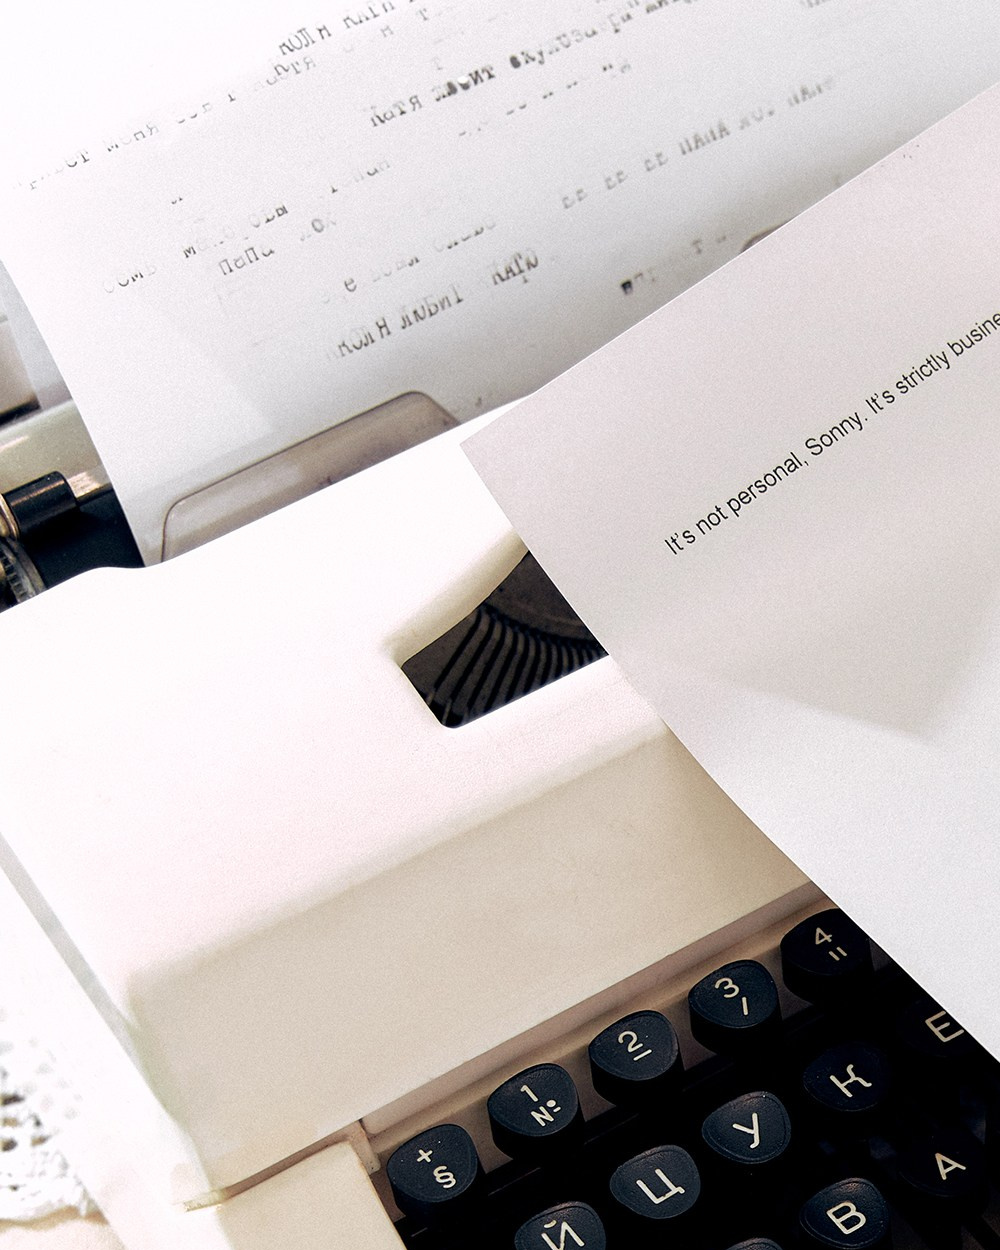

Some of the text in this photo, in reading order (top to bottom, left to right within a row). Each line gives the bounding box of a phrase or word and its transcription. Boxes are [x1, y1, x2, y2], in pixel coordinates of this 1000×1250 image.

[664, 528, 697, 556] It's
[695, 505, 729, 535] not
[726, 451, 810, 518] personal,
[804, 411, 869, 457] Sonny.
[865, 392, 896, 415] It's
[895, 349, 951, 395] strictly
[814, 927, 833, 945] 4
[714, 977, 740, 998] 3
[520, 1085, 538, 1102] 1
[829, 1064, 873, 1097] К
[732, 1113, 760, 1149] У
[934, 1152, 966, 1181] А
[636, 1168, 685, 1205] Ц
[826, 1201, 867, 1235] В
